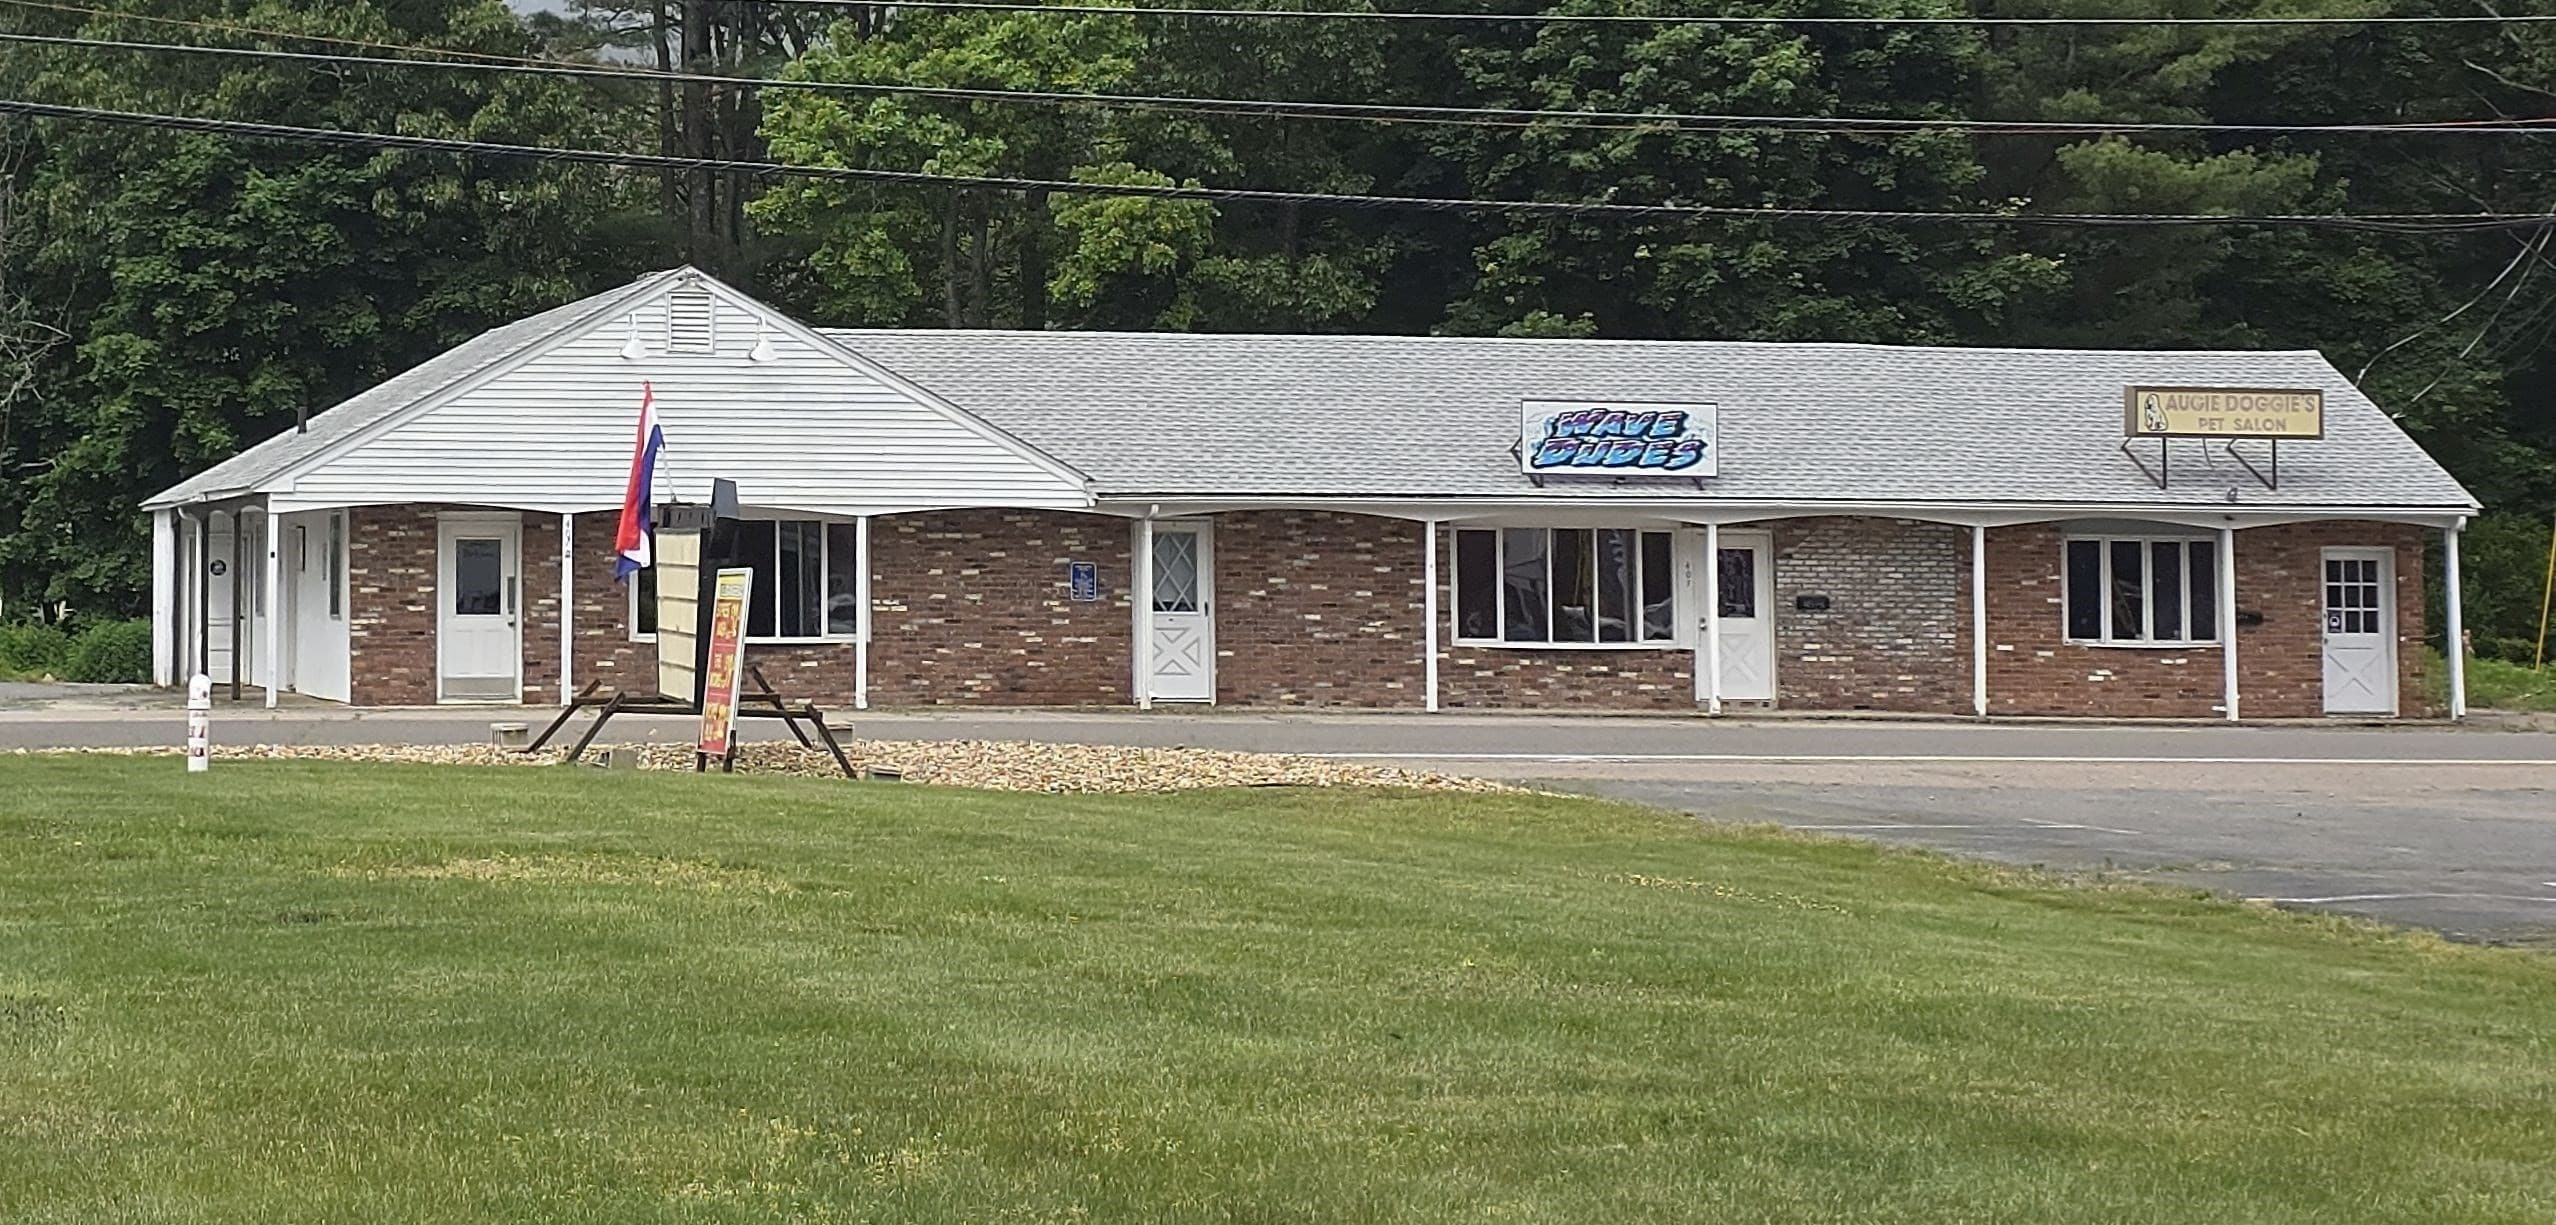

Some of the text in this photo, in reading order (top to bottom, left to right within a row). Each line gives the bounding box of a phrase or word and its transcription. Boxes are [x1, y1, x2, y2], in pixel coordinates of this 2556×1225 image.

[2165, 394, 2316, 413] AUGIE DOGGIE'S
[1552, 408, 1688, 438] WAVE
[2198, 417, 2287, 432] PET SALON
[1531, 437, 1708, 470] DUDES
